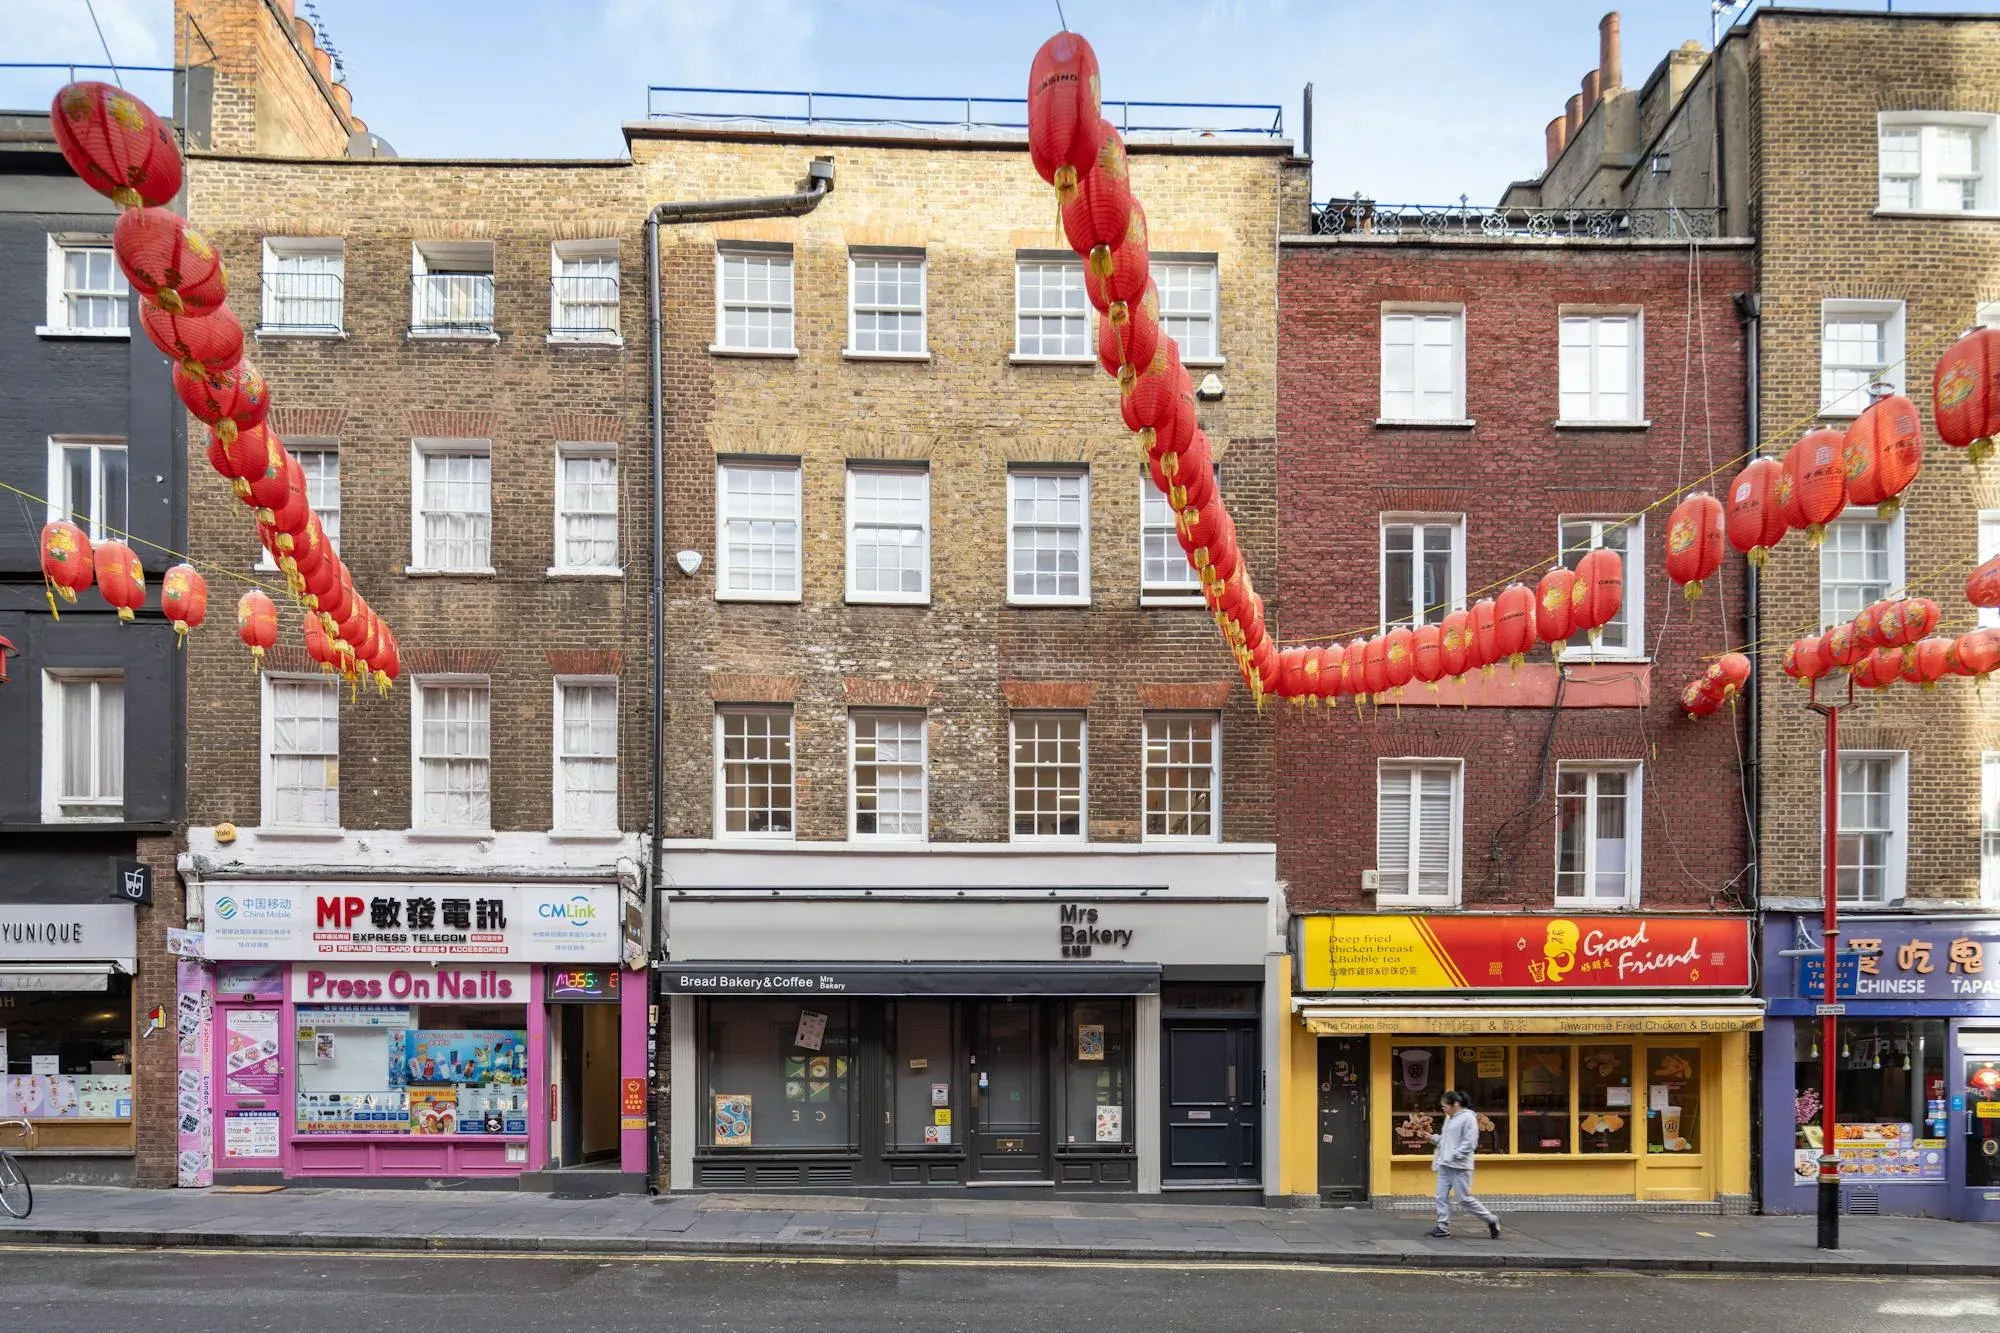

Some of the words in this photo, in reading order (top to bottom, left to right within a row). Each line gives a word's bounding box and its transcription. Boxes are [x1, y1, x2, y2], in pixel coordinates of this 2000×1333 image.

[243, 897, 292, 909] 中国移动
[243, 911, 265, 919] China
[266, 911, 292, 919] Mobile
[316, 896, 366, 928] MP
[370, 896, 507, 930] 敏發電訊
[538, 902, 596, 919] CMLink
[1060, 904, 1099, 923] Mrs
[2, 923, 82, 942] YUNIQUE
[352, 933, 407, 942] EXPRESS
[412, 934, 467, 943] TELECOM
[1060, 925, 1134, 948] Bakery
[1329, 935, 1360, 944] Deep
[1364, 934, 1392, 943] fried
[1583, 920, 1649, 957] Good
[1329, 945, 1373, 953] chicken
[1377, 945, 1413, 953] breast
[1339, 955, 1379, 963] Bubble
[1383, 955, 1401, 963] tea
[1617, 936, 1701, 980] Friend
[820, 975, 834, 983] Mrs
[1812, 971, 1847, 979] Taas
[307, 969, 382, 999] Press
[388, 969, 431, 999] On
[437, 969, 513, 999] Nails
[680, 975, 717, 987] Bread
[820, 982, 846, 991] Bakery
[1809, 981, 1849, 989] Hose
[1857, 979, 1926, 993] CHINESE
[1321, 1021, 1338, 1030] The
[1340, 1021, 1374, 1030] Chicken
[1376, 1021, 1399, 1032] Shop
[1488, 1021, 1497, 1031] &
[1559, 1021, 1613, 1031] Taiwanese
[1616, 1021, 1642, 1031] Fried
[1645, 1021, 1687, 1031] Chicken
[1690, 1021, 1698, 1031] &
[1701, 1021, 1737, 1031] Bubble
[1740, 1021, 1757, 1030] Tea
